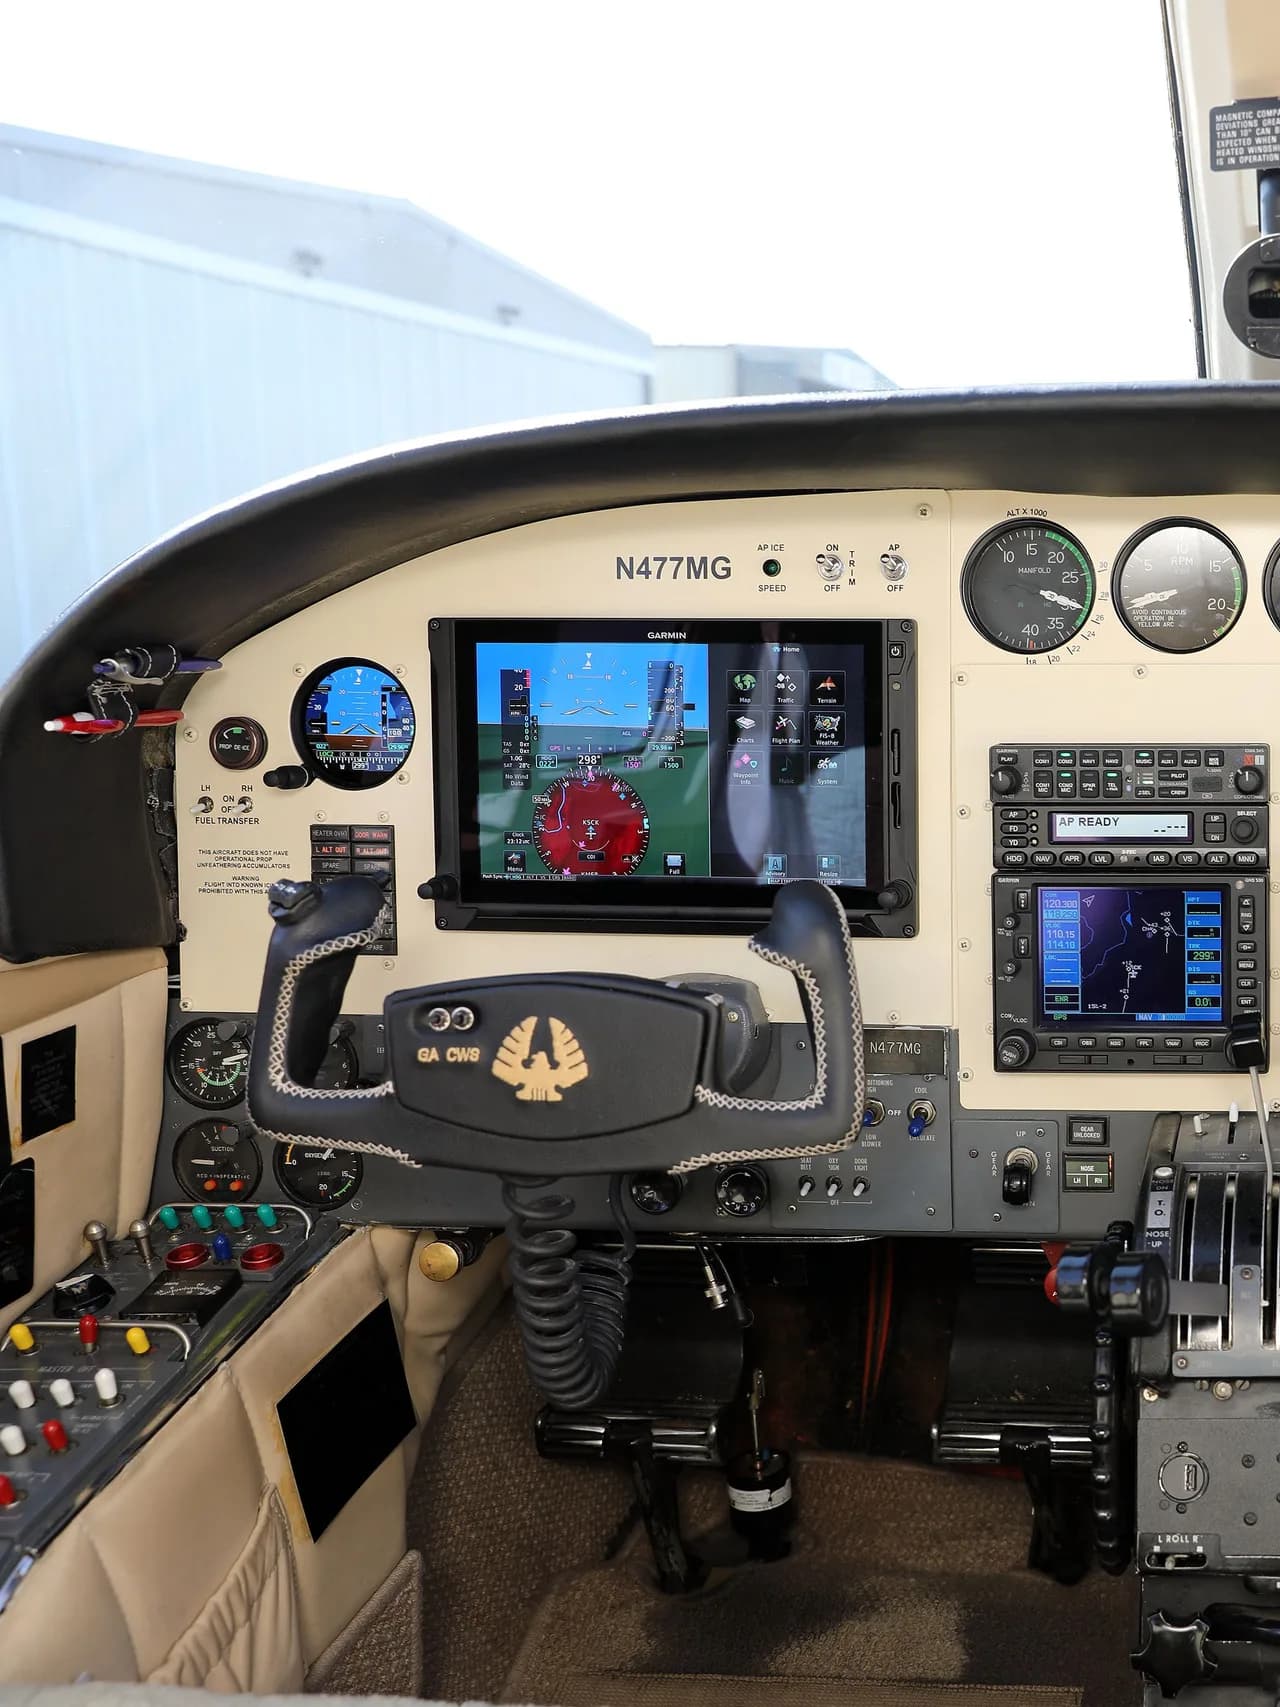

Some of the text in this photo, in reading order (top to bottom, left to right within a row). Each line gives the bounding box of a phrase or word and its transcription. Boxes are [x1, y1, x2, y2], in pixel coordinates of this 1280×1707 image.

[1215, 111, 1254, 122] MAGNETIC
[1216, 119, 1258, 131] DEVIATIONS
[1216, 130, 1237, 139] THAN
[1255, 127, 1271, 136] CAN
[1216, 138, 1252, 149] EXPECTED
[1254, 135, 1277, 145] WHEN
[1216, 147, 1244, 157] HEATED
[1216, 153, 1280, 166] IS IN OPERATION
[1006, 508, 1020, 517] ALT
[1030, 508, 1048, 518] 1000
[757, 544, 785, 552] AP ICE
[1026, 543, 1038, 556] 15
[1003, 551, 1015, 563] 10
[1047, 552, 1065, 564] 20
[615, 556, 732, 580] N477MG
[1209, 560, 1221, 573] 15
[1062, 572, 1079, 584] 25
[758, 584, 787, 592] SPEED
[823, 584, 841, 592] OFF
[887, 584, 904, 592] OFF
[1207, 598, 1226, 611] 20
[1047, 617, 1065, 630] 35
[1021, 624, 1039, 636] 40
[222, 795, 235, 803] ON
[195, 817, 260, 825] FUEL TRANSFER
[1059, 817, 1120, 827] AP READY
[1210, 855, 1224, 863] ALT
[870, 1041, 921, 1055] N477MG
[417, 1047, 481, 1063] GA CWS
[1145, 1230, 1169, 1238] NOSE
[1151, 1240, 1162, 1248] UP
[1157, 1534, 1199, 1544] L ROLL R
